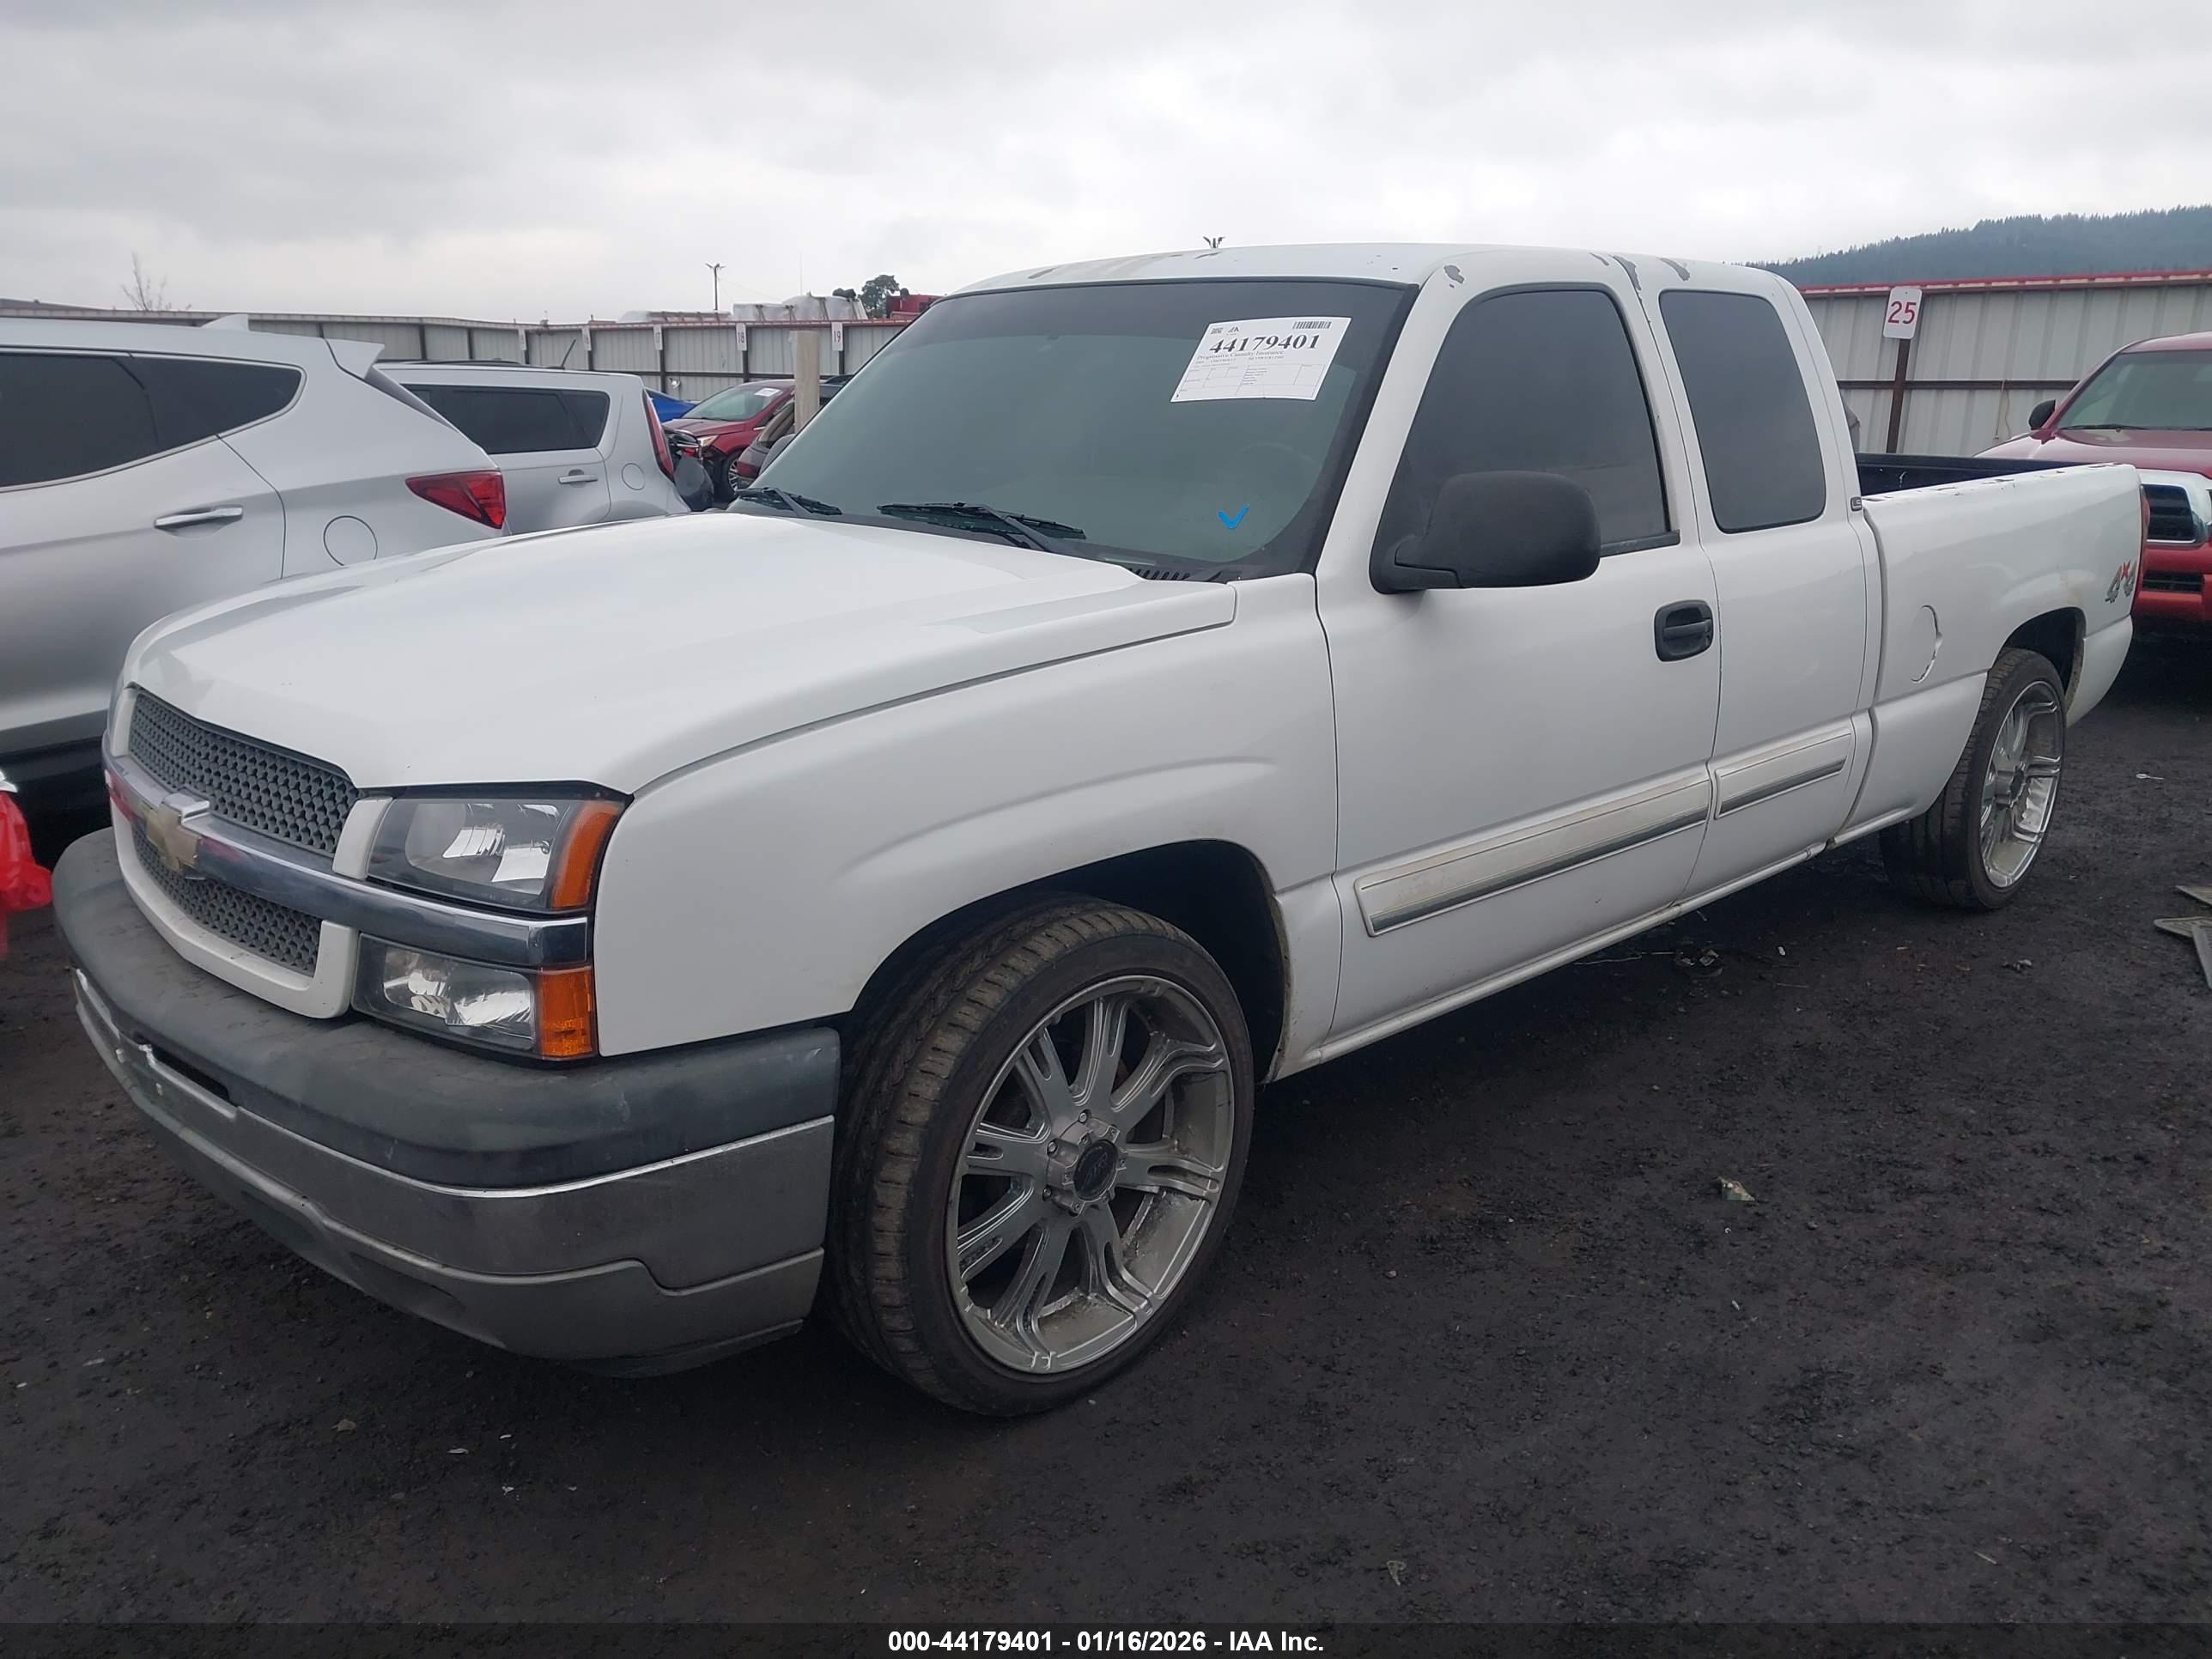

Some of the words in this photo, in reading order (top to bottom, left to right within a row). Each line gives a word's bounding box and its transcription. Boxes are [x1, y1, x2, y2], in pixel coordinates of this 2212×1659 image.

[1887, 301, 1917, 325] 25
[834, 331, 842, 343] 19
[1209, 333, 1321, 354] 44179401
